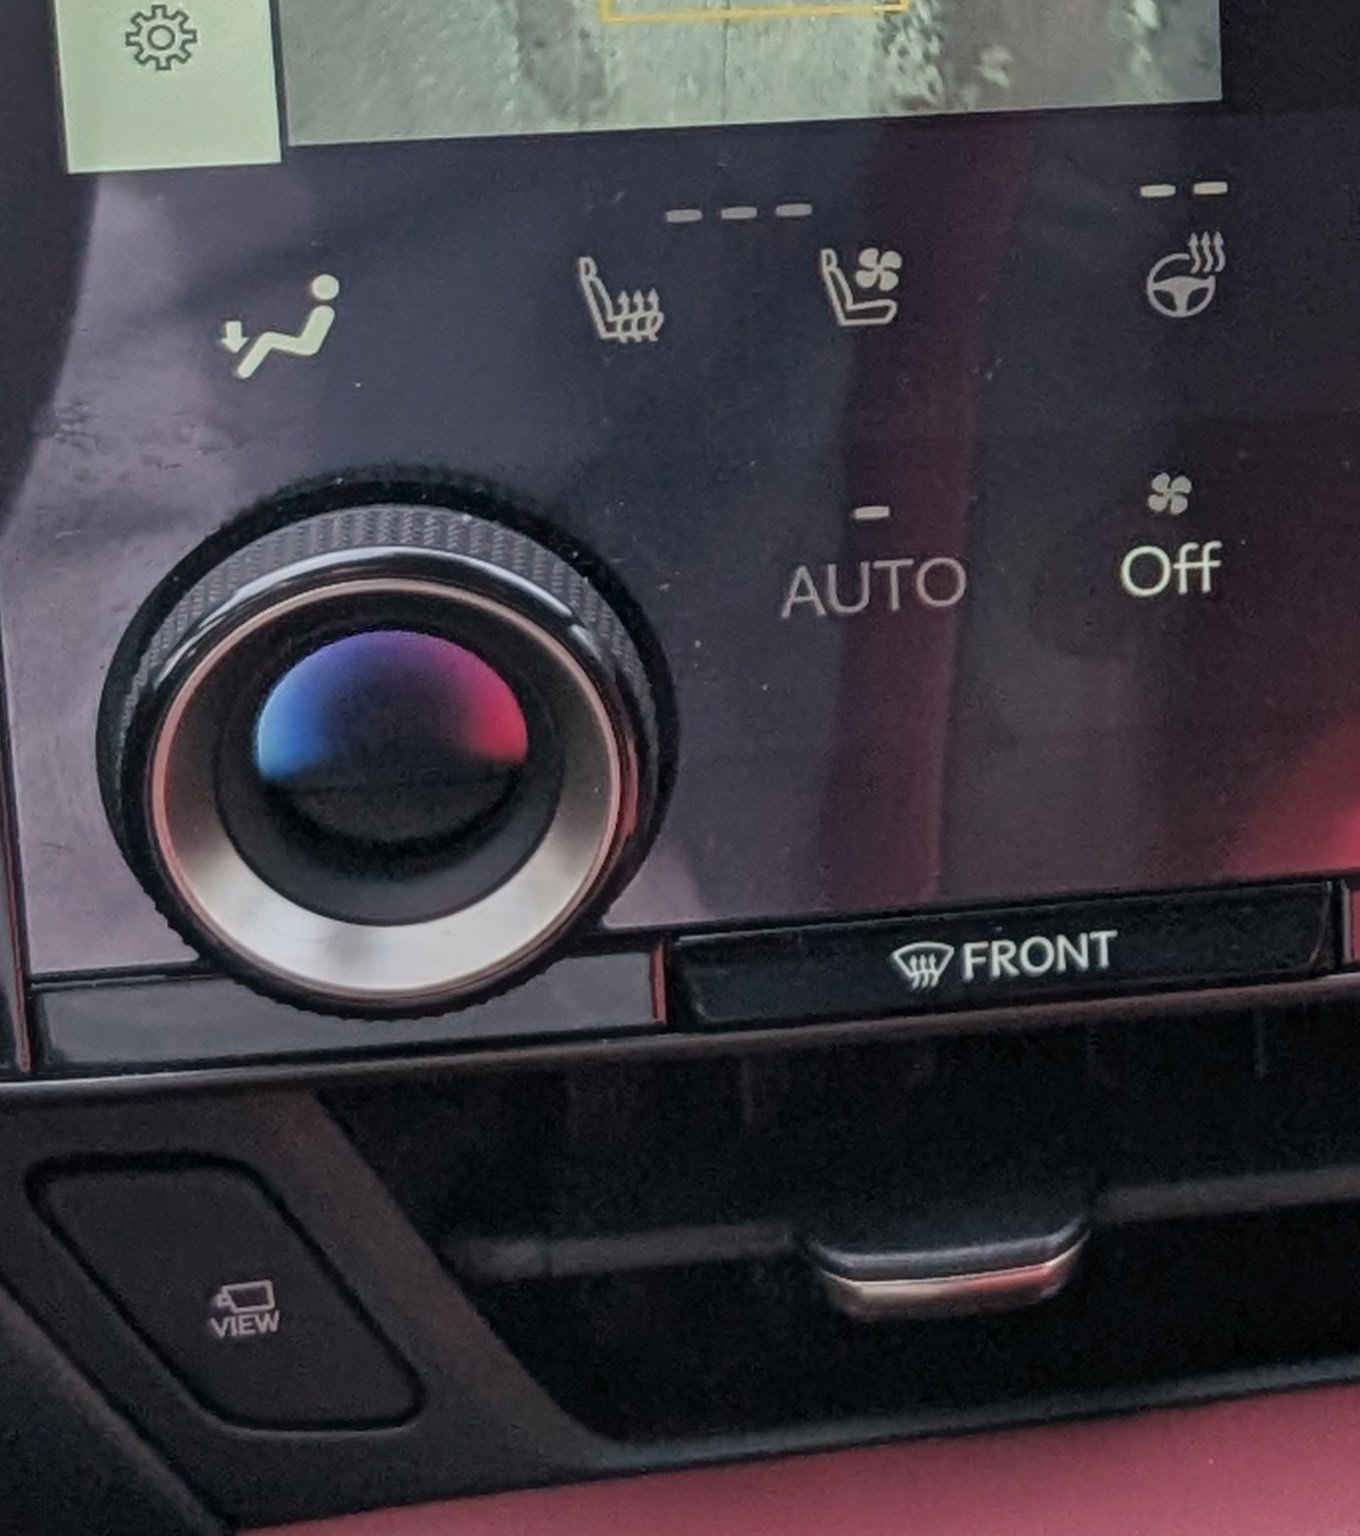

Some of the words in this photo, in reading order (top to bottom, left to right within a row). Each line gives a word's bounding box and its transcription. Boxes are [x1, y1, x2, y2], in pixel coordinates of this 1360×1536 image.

[780, 556, 967, 618] AUTO
[1120, 540, 1223, 597] Off
[962, 929, 1118, 982] FRONT
[209, 1309, 280, 1338] VIEW
